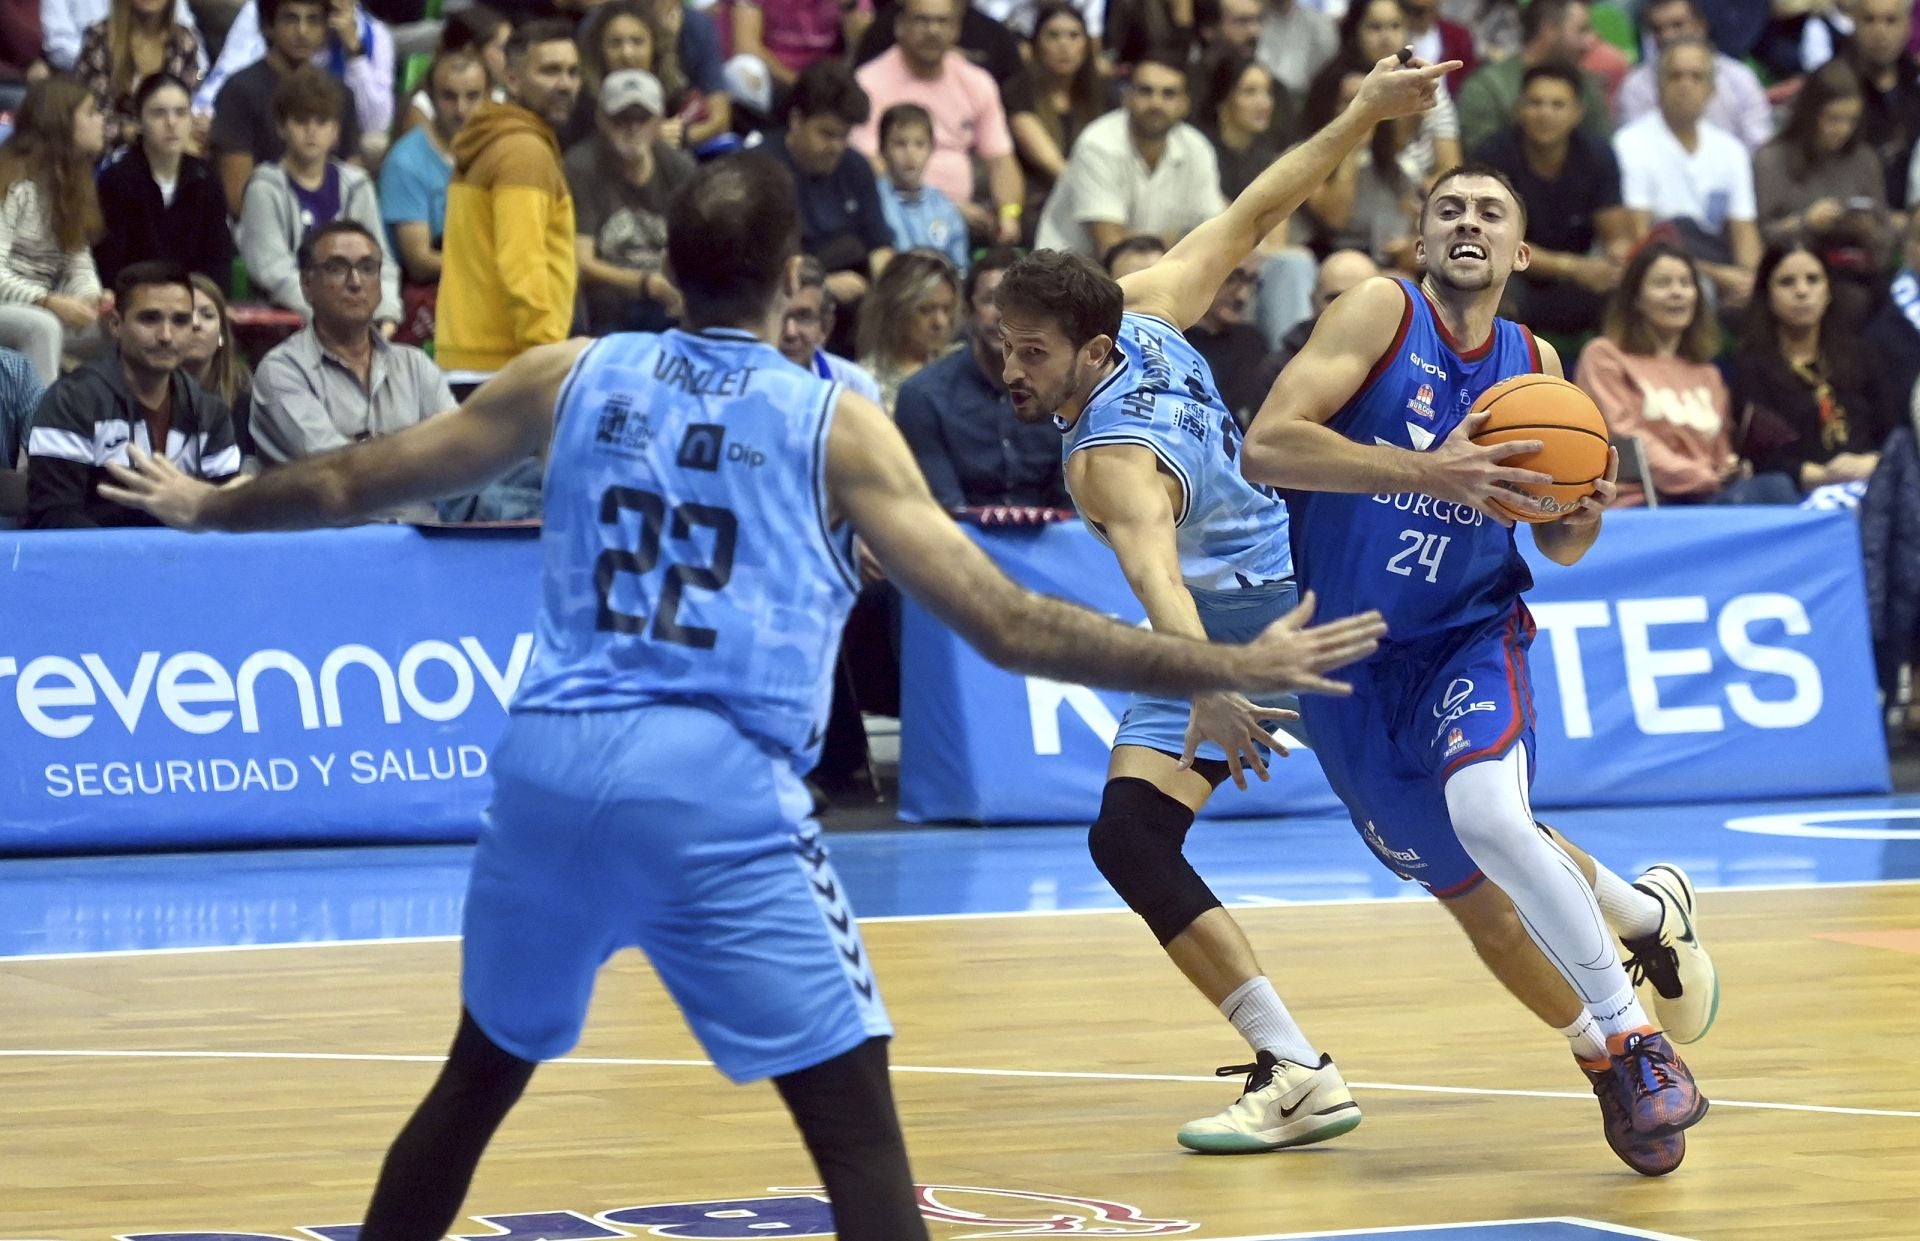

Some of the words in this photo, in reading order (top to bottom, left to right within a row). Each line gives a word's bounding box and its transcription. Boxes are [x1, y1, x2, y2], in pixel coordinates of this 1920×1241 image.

[1410, 352, 1447, 381] GIVOVA
[593, 484, 738, 651] 22
[1386, 529, 1451, 583] 24
[0, 632, 534, 739] evennov
[44, 758, 299, 798] SEGURIDAD
[310, 753, 336, 786] Y
[349, 745, 488, 784] SALUD
